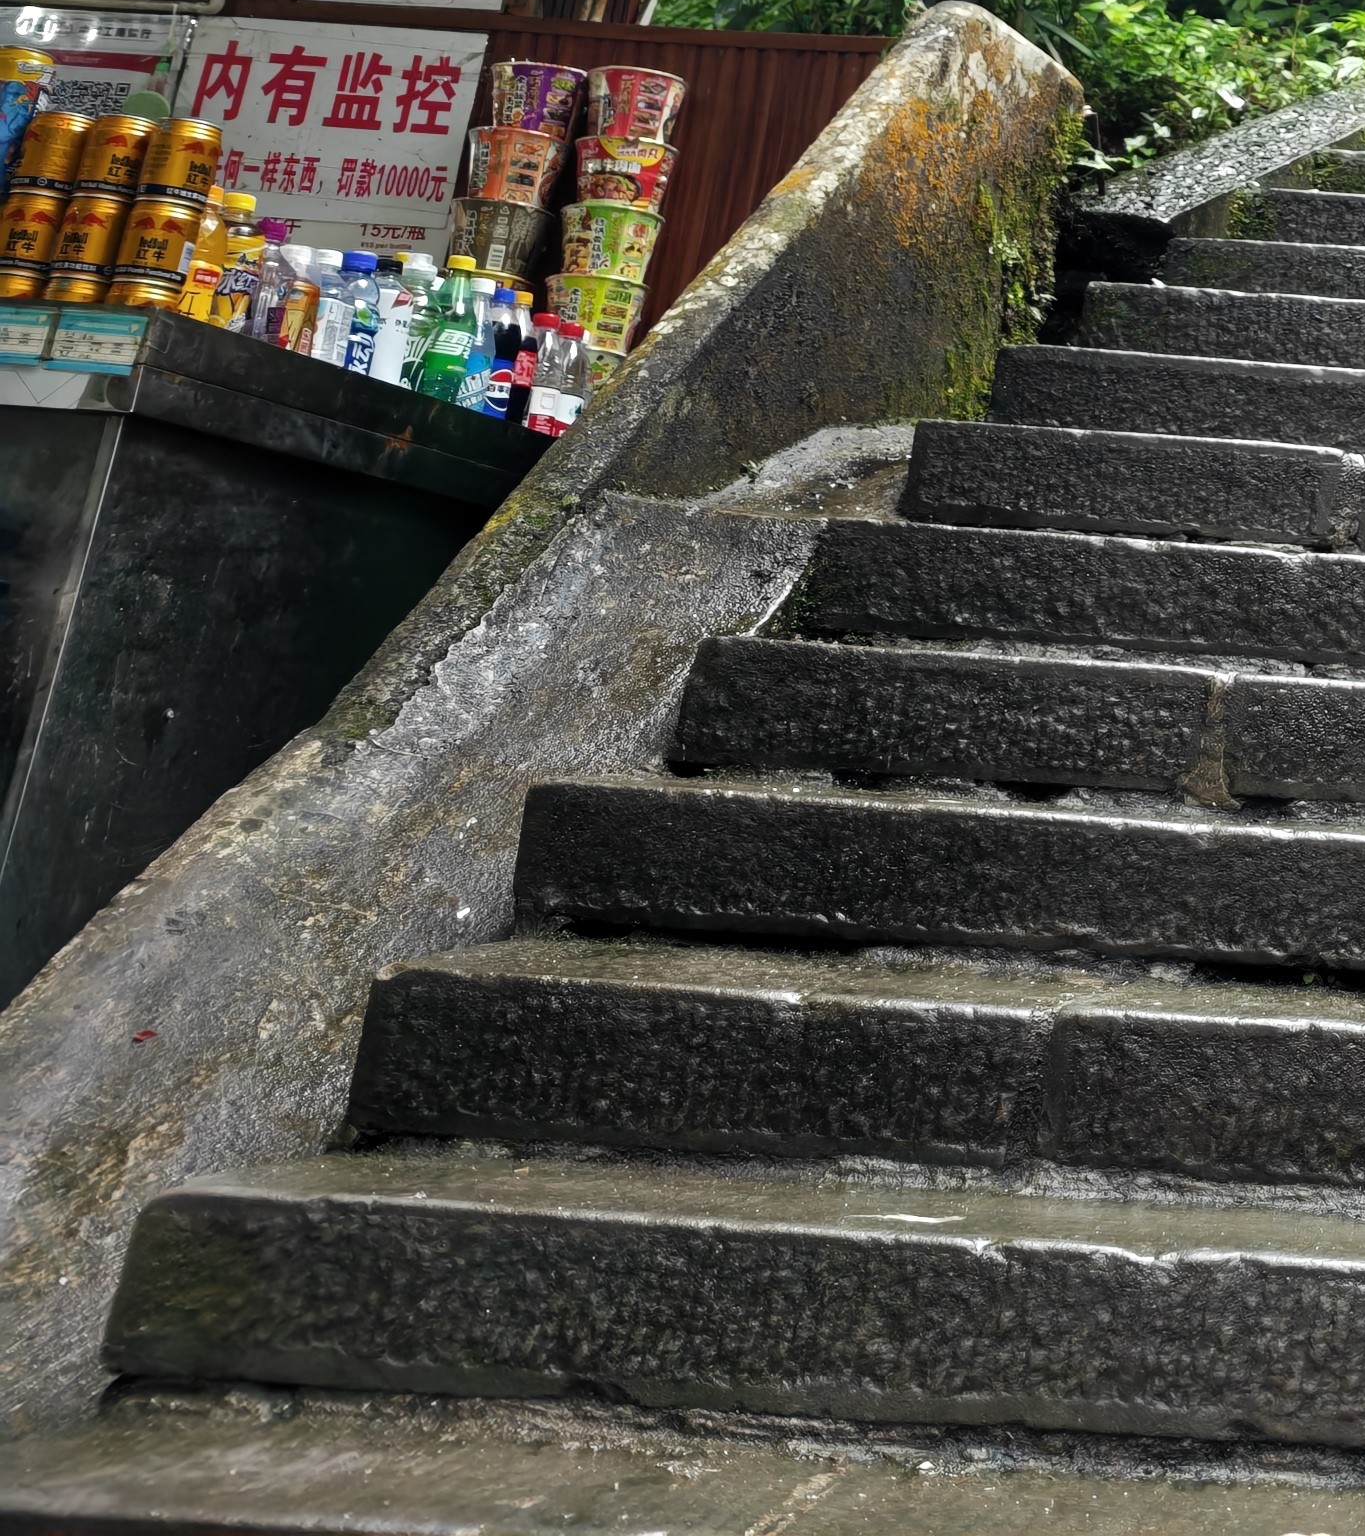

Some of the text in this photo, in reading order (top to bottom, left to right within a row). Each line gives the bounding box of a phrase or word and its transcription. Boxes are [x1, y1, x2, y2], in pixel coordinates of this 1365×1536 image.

[191, 40, 461, 135] 内有监控
[215, 147, 447, 203] 何一样东西，罚款10000元
[136, 248, 166, 262] 红牛
